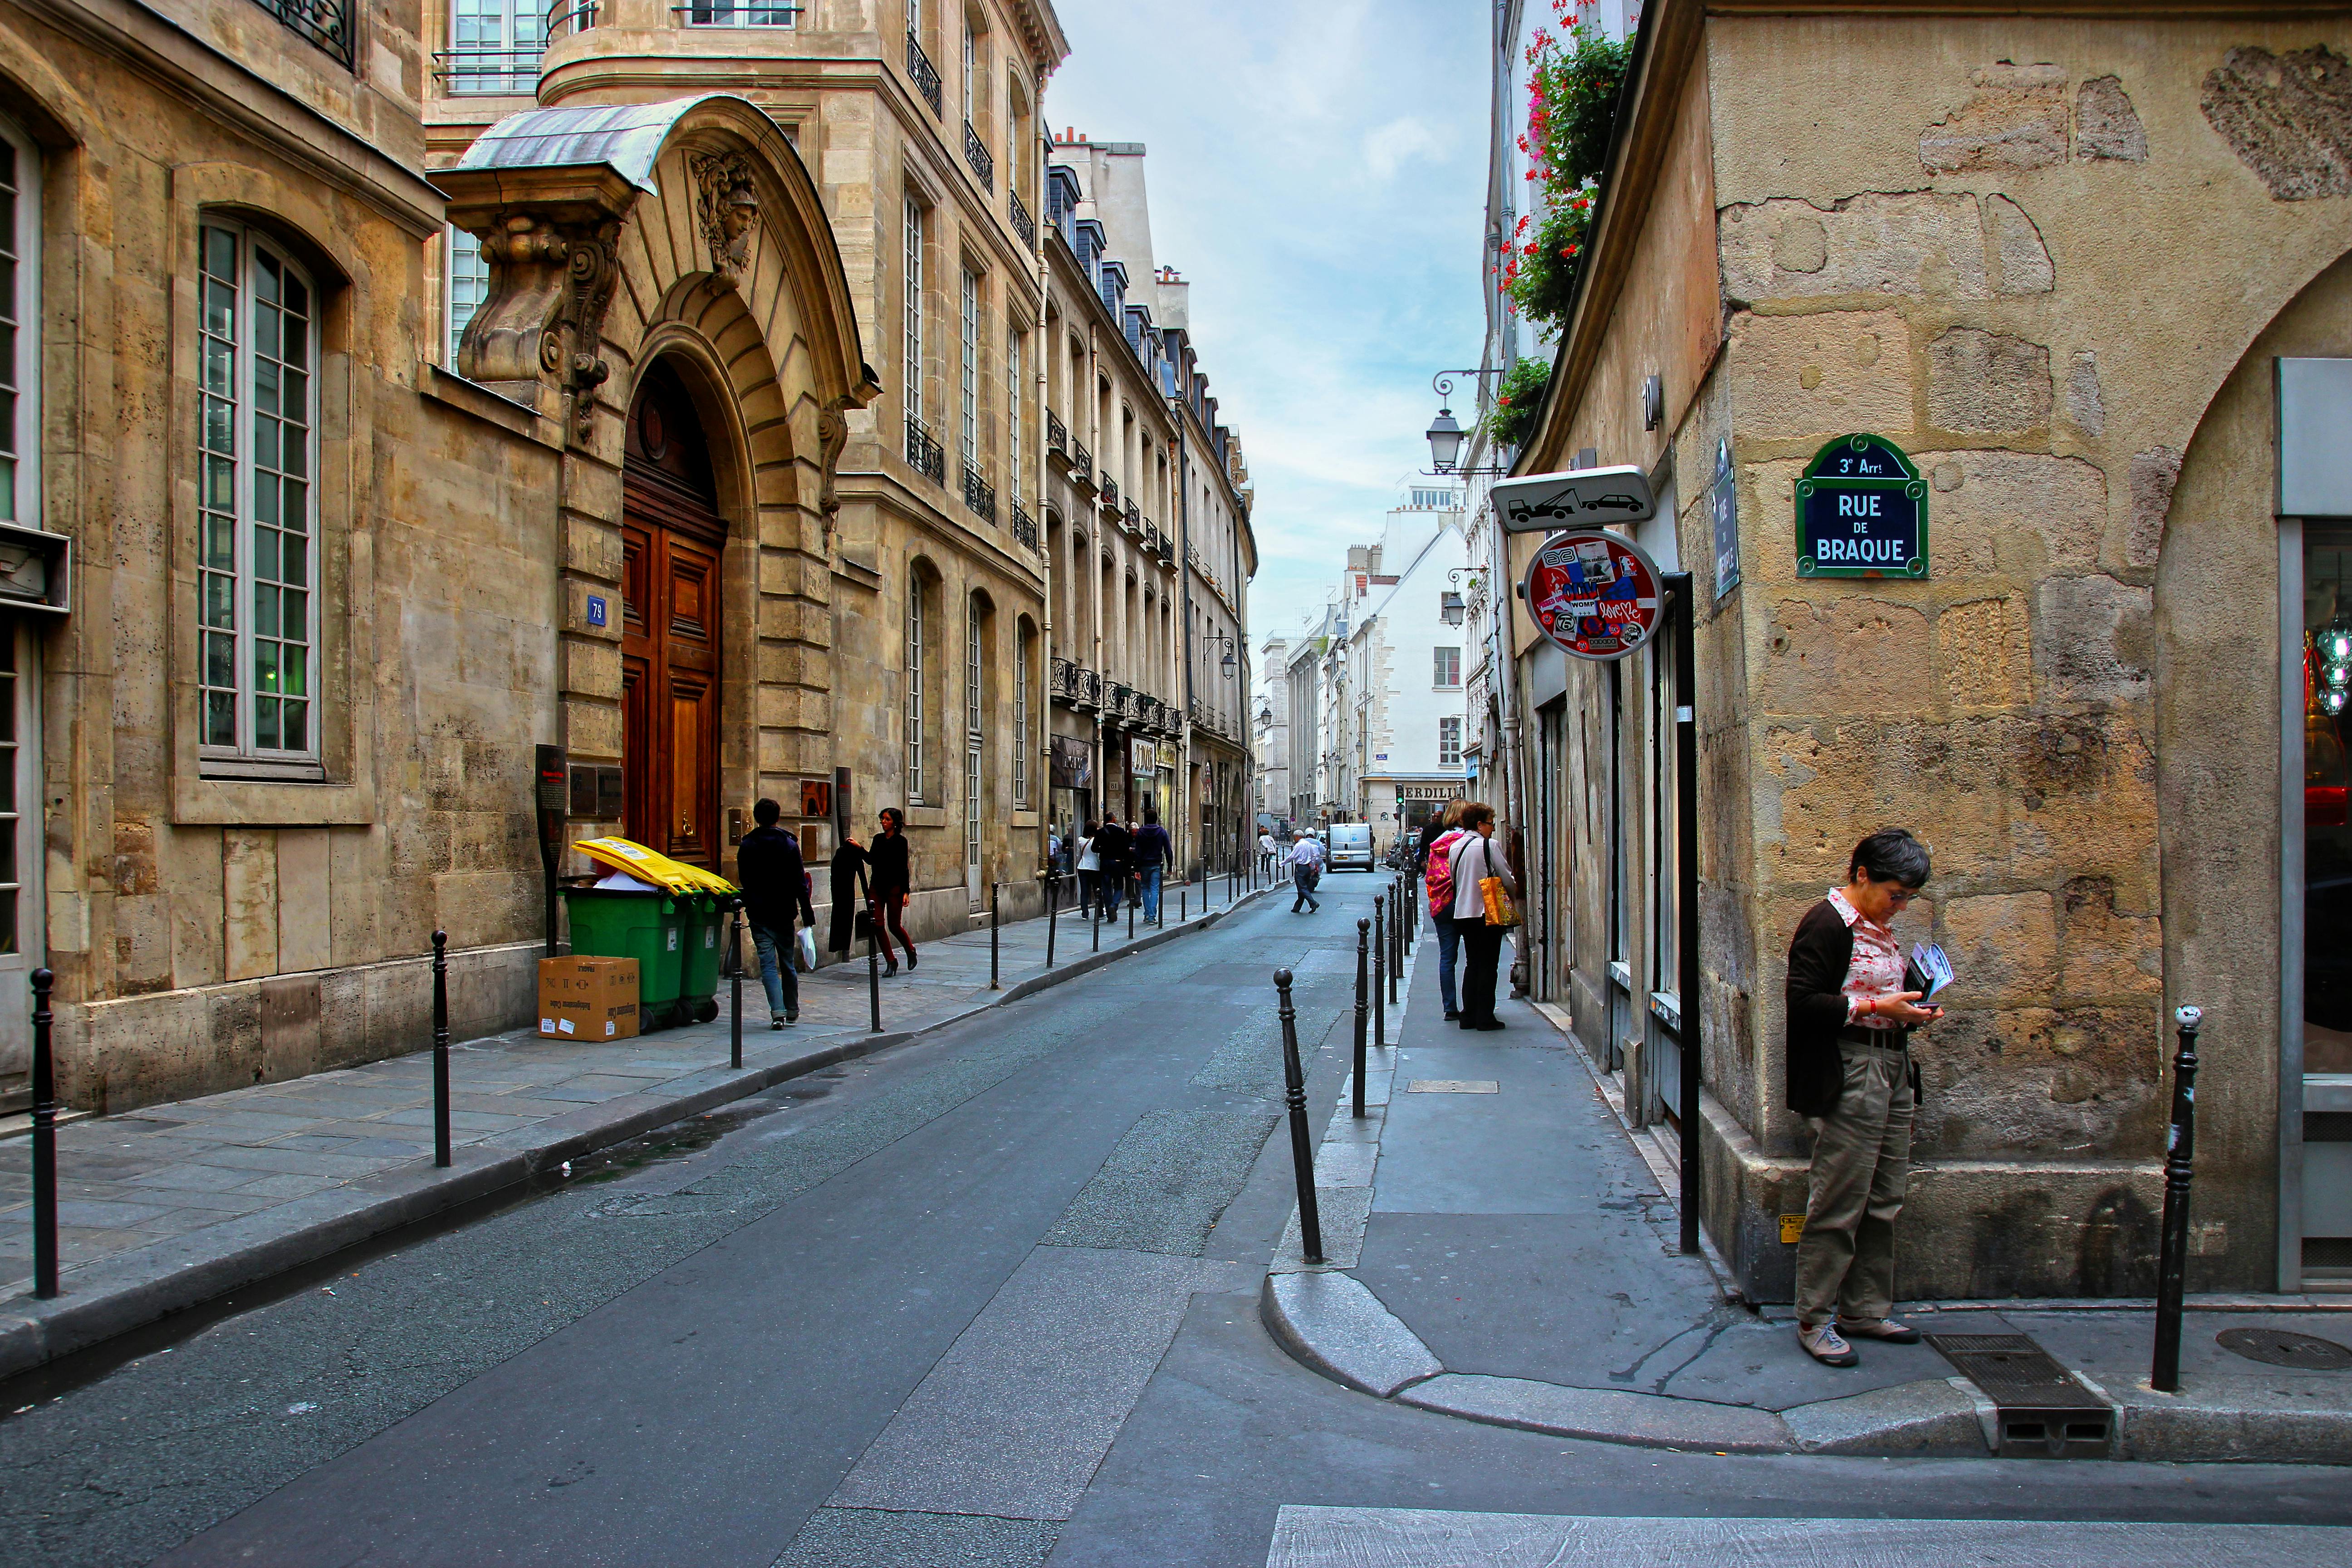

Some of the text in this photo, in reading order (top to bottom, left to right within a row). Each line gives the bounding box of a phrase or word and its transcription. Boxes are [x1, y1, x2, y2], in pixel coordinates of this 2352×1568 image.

[1839, 495, 1881, 516] RUE
[1853, 522, 1868, 534] DE
[1817, 539, 1904, 562] BRAQUE
[593, 603, 602, 618] 79
